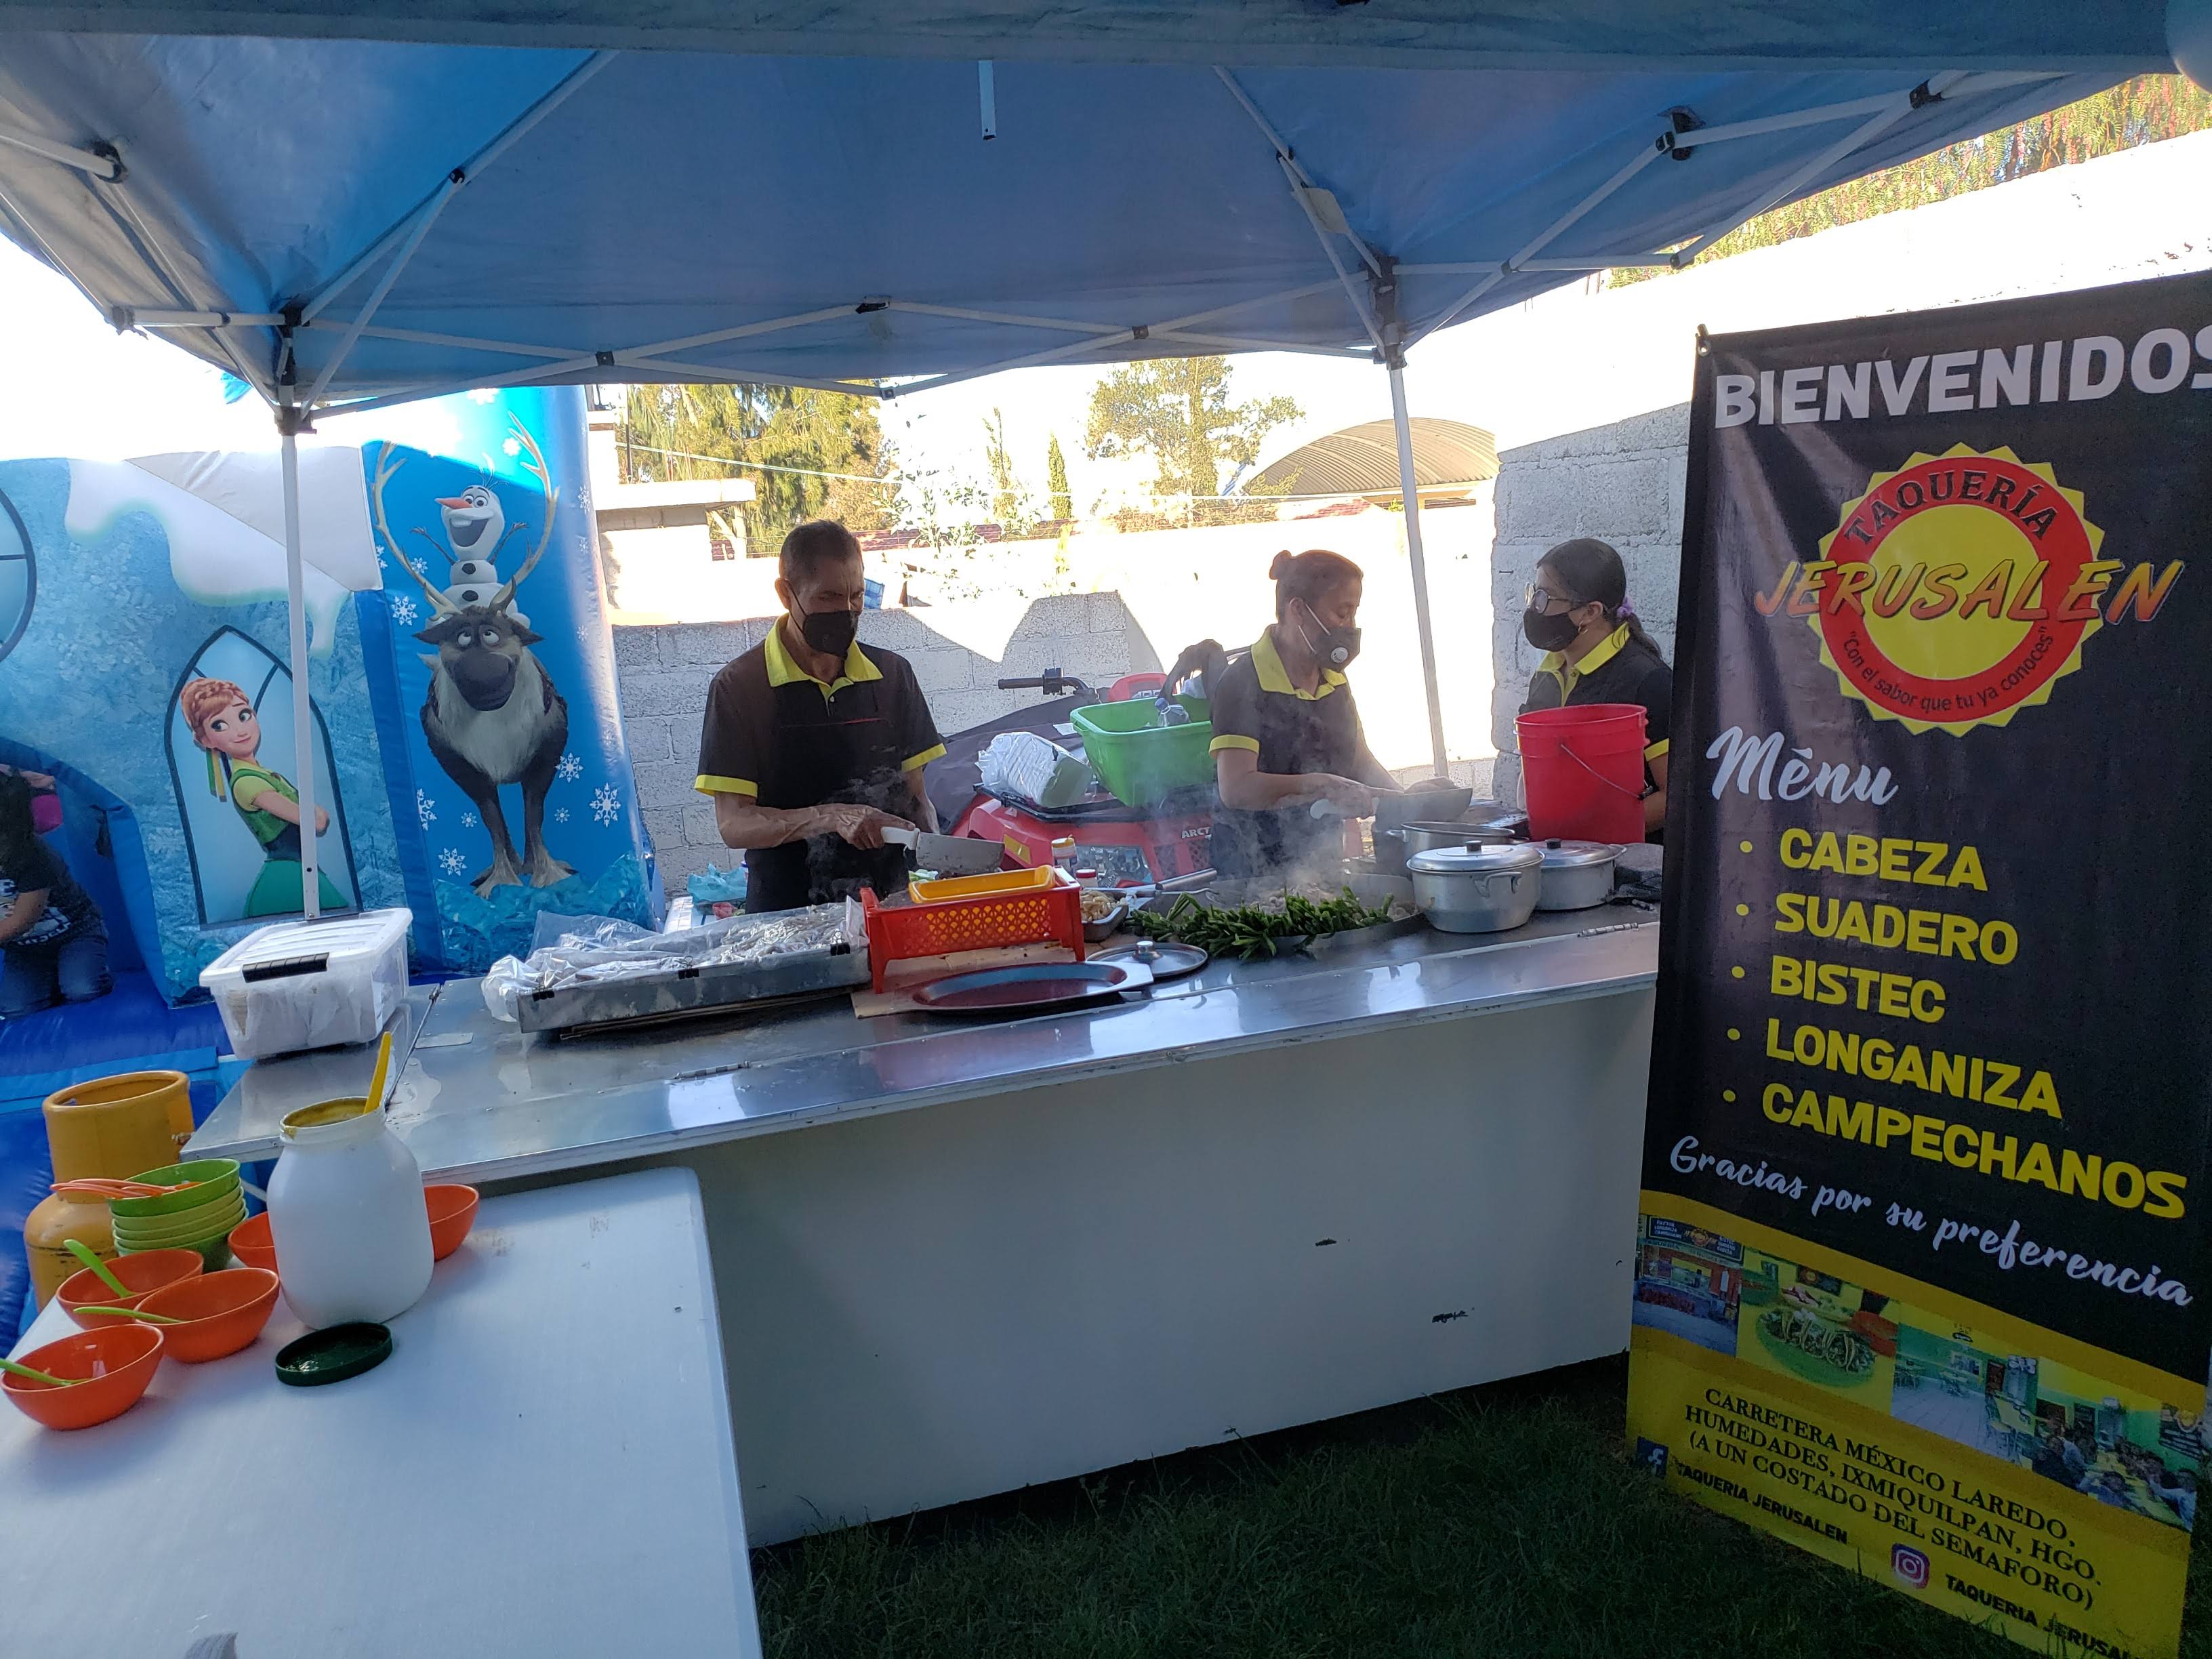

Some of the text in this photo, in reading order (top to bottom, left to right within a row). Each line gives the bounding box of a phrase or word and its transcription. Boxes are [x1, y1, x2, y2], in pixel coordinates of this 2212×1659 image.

[1843, 470, 2058, 545] TAQUERÍA
[1755, 559, 2185, 623] JERUSALEN
[1863, 667, 1877, 682] el
[1875, 677, 1917, 705] sabor
[1920, 697, 1952, 713] que
[1956, 694, 1973, 709] tu
[1977, 687, 1999, 705] ya
[1181, 827, 1210, 839] ARCT
[1780, 827, 1988, 891] CABEZA
[1774, 893, 2019, 965] SUADERO
[1771, 954, 1946, 1023] BISTEC
[1766, 1019, 2062, 1118] LONGANIZA
[1762, 1083, 2188, 1218] CAMPECHANOS
[1671, 1136, 2193, 1307] Gracias por su preferencia
[1676, 1462, 1847, 1545] TAQUERIA JERUSALEN
[1685, 1404, 2102, 1586] HUMEDADES, IXMIQUILPAN, HGO.
[1705, 1389, 2076, 1547] CARRETERA MÉXICO LAREDO,
[1689, 1430, 2093, 1611] (A UN COSTADO DEL SEMAFORO)
[1945, 1574, 2140, 1659] TAQUERIA JERUSA
